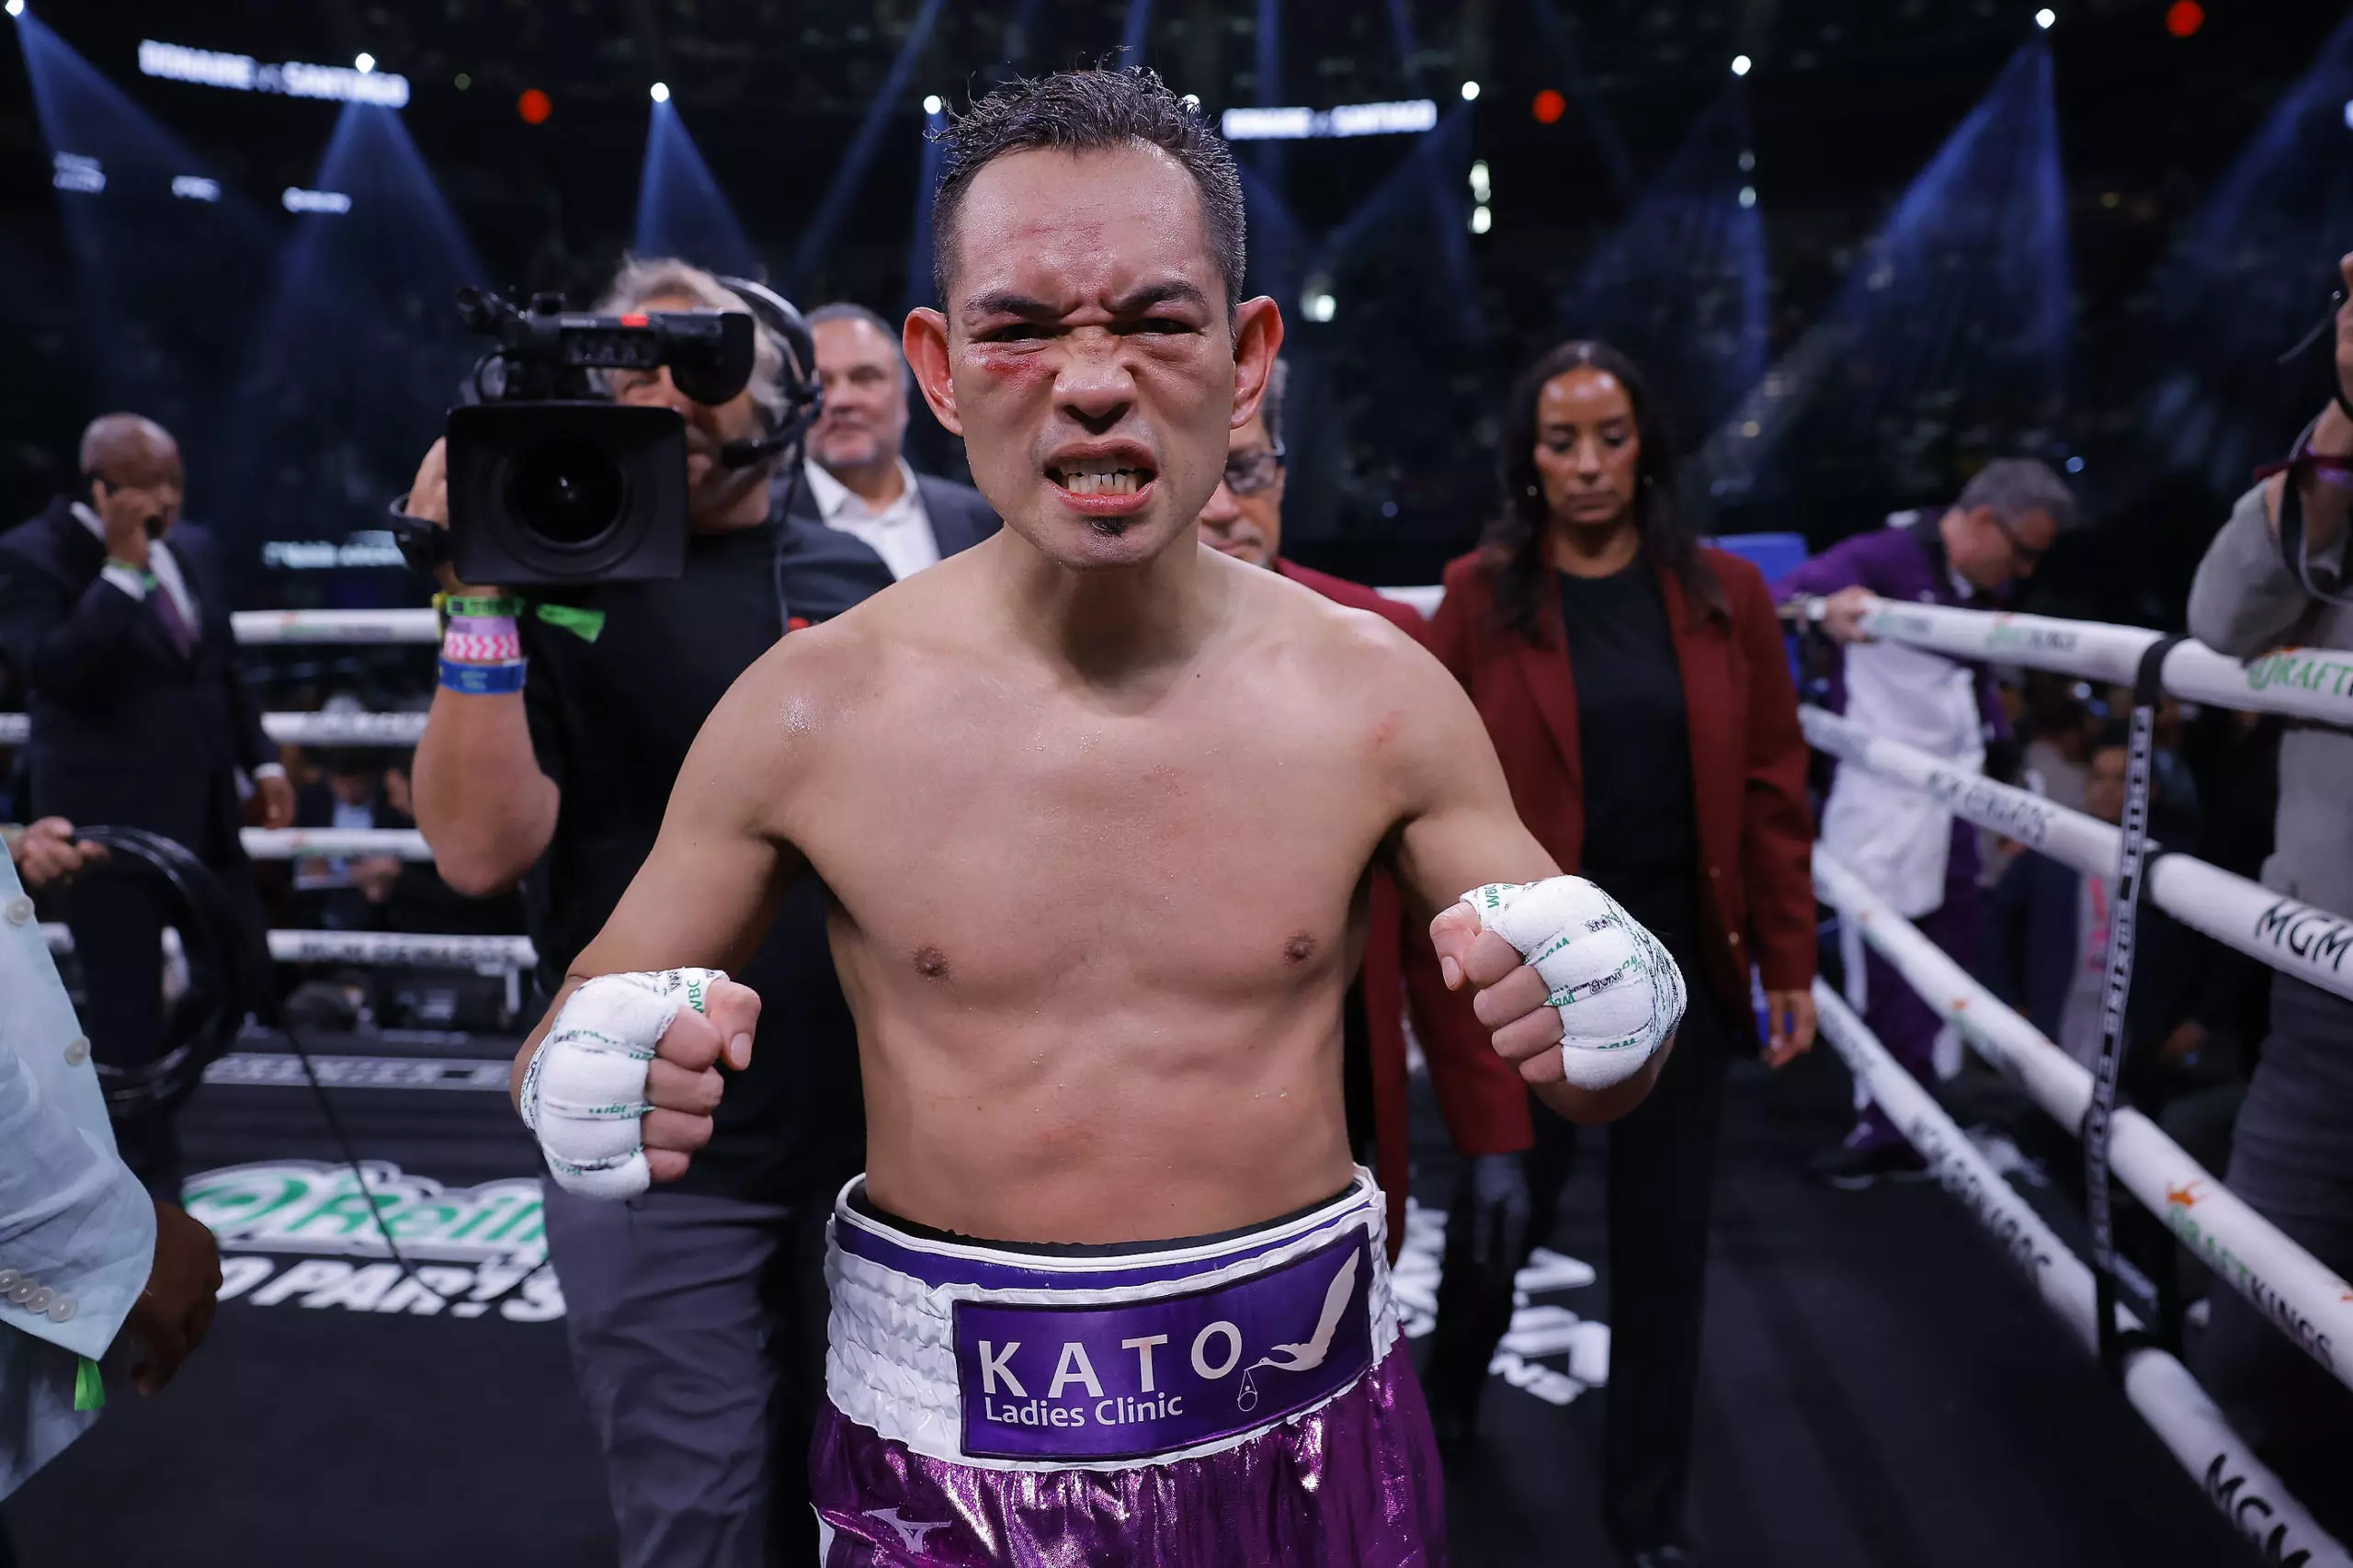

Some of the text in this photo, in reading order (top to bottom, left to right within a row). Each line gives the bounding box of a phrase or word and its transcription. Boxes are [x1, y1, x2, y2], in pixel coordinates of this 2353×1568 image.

[2247, 654, 2353, 696] DRAFT
[2255, 899, 2353, 971] MGM
[978, 1320, 1243, 1398] KATO
[983, 1392, 1184, 1427] Ladies Clinic
